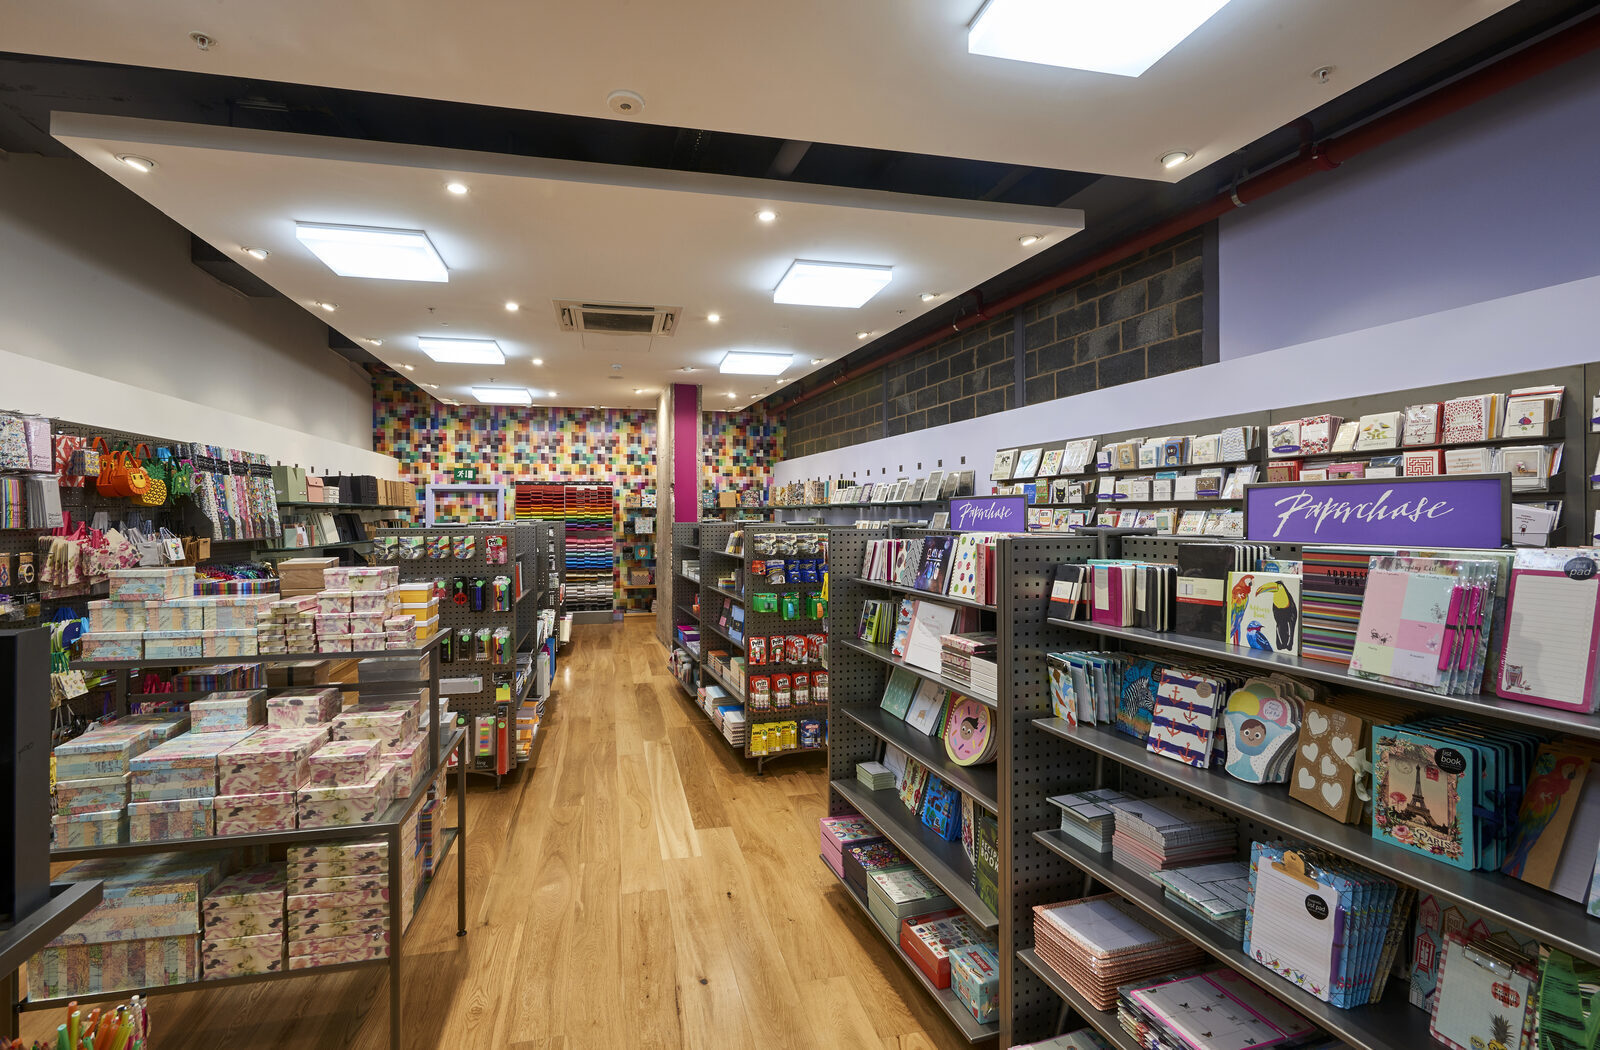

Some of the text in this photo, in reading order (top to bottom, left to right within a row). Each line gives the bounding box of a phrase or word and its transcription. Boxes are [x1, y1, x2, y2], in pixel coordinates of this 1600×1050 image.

[958, 502, 1013, 529] Paperchase
[1273, 489, 1454, 537] Paperchase
[1569, 567, 1592, 577] pad
[1334, 578, 1360, 587] BOOK
[1441, 755, 1461, 766] book
[1415, 828, 1450, 849] PARIS
[1315, 904, 1326, 912] pad
